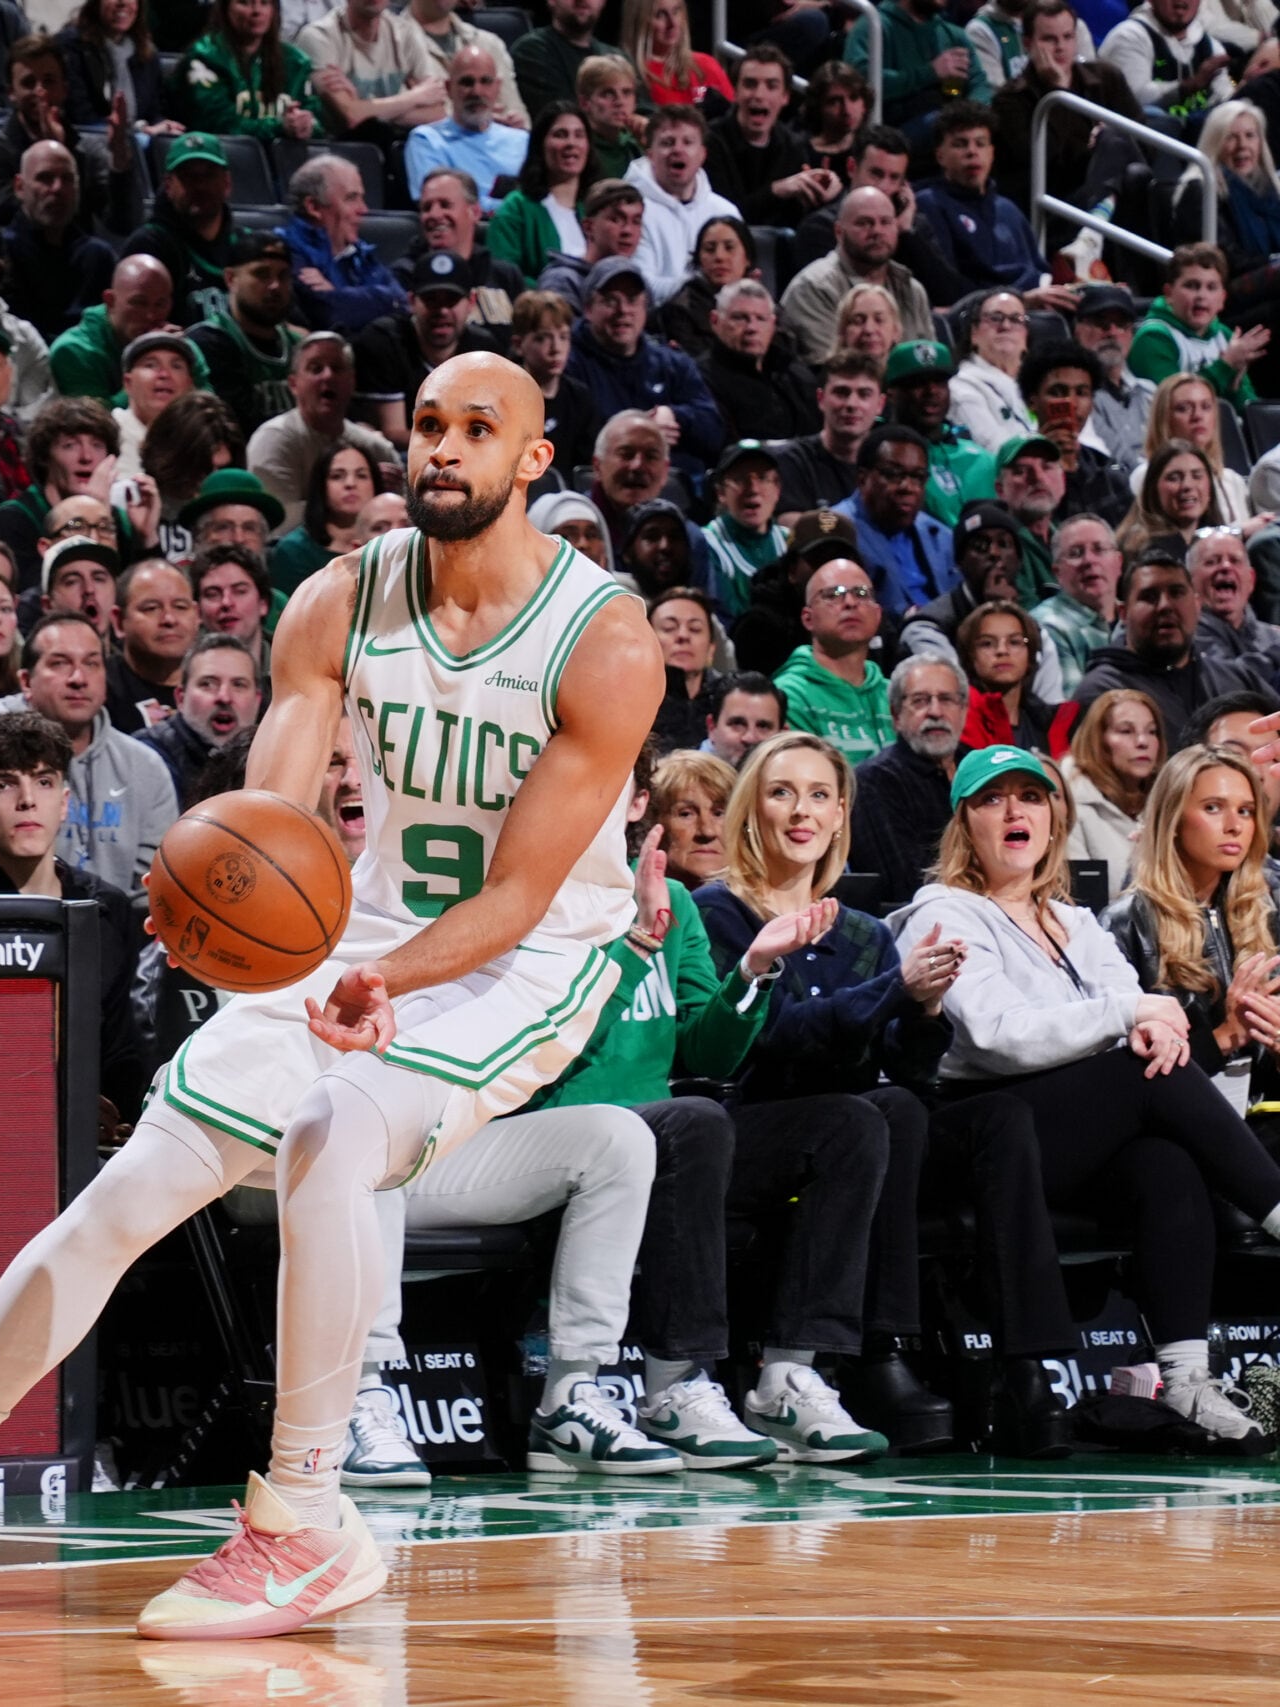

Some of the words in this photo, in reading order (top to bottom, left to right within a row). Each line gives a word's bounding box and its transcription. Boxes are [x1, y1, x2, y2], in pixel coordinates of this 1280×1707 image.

[484, 670, 539, 693] Amica
[357, 697, 540, 812] CELTICS
[402, 823, 484, 918] 9
[1090, 1331, 1124, 1345] SEAT
[1127, 1331, 1137, 1344] 9
[1228, 1325, 1261, 1340] ROW
[964, 1334, 992, 1349] FLR
[424, 1353, 461, 1369] SEAT
[464, 1353, 475, 1368] 6
[623, 1346, 644, 1361] AA
